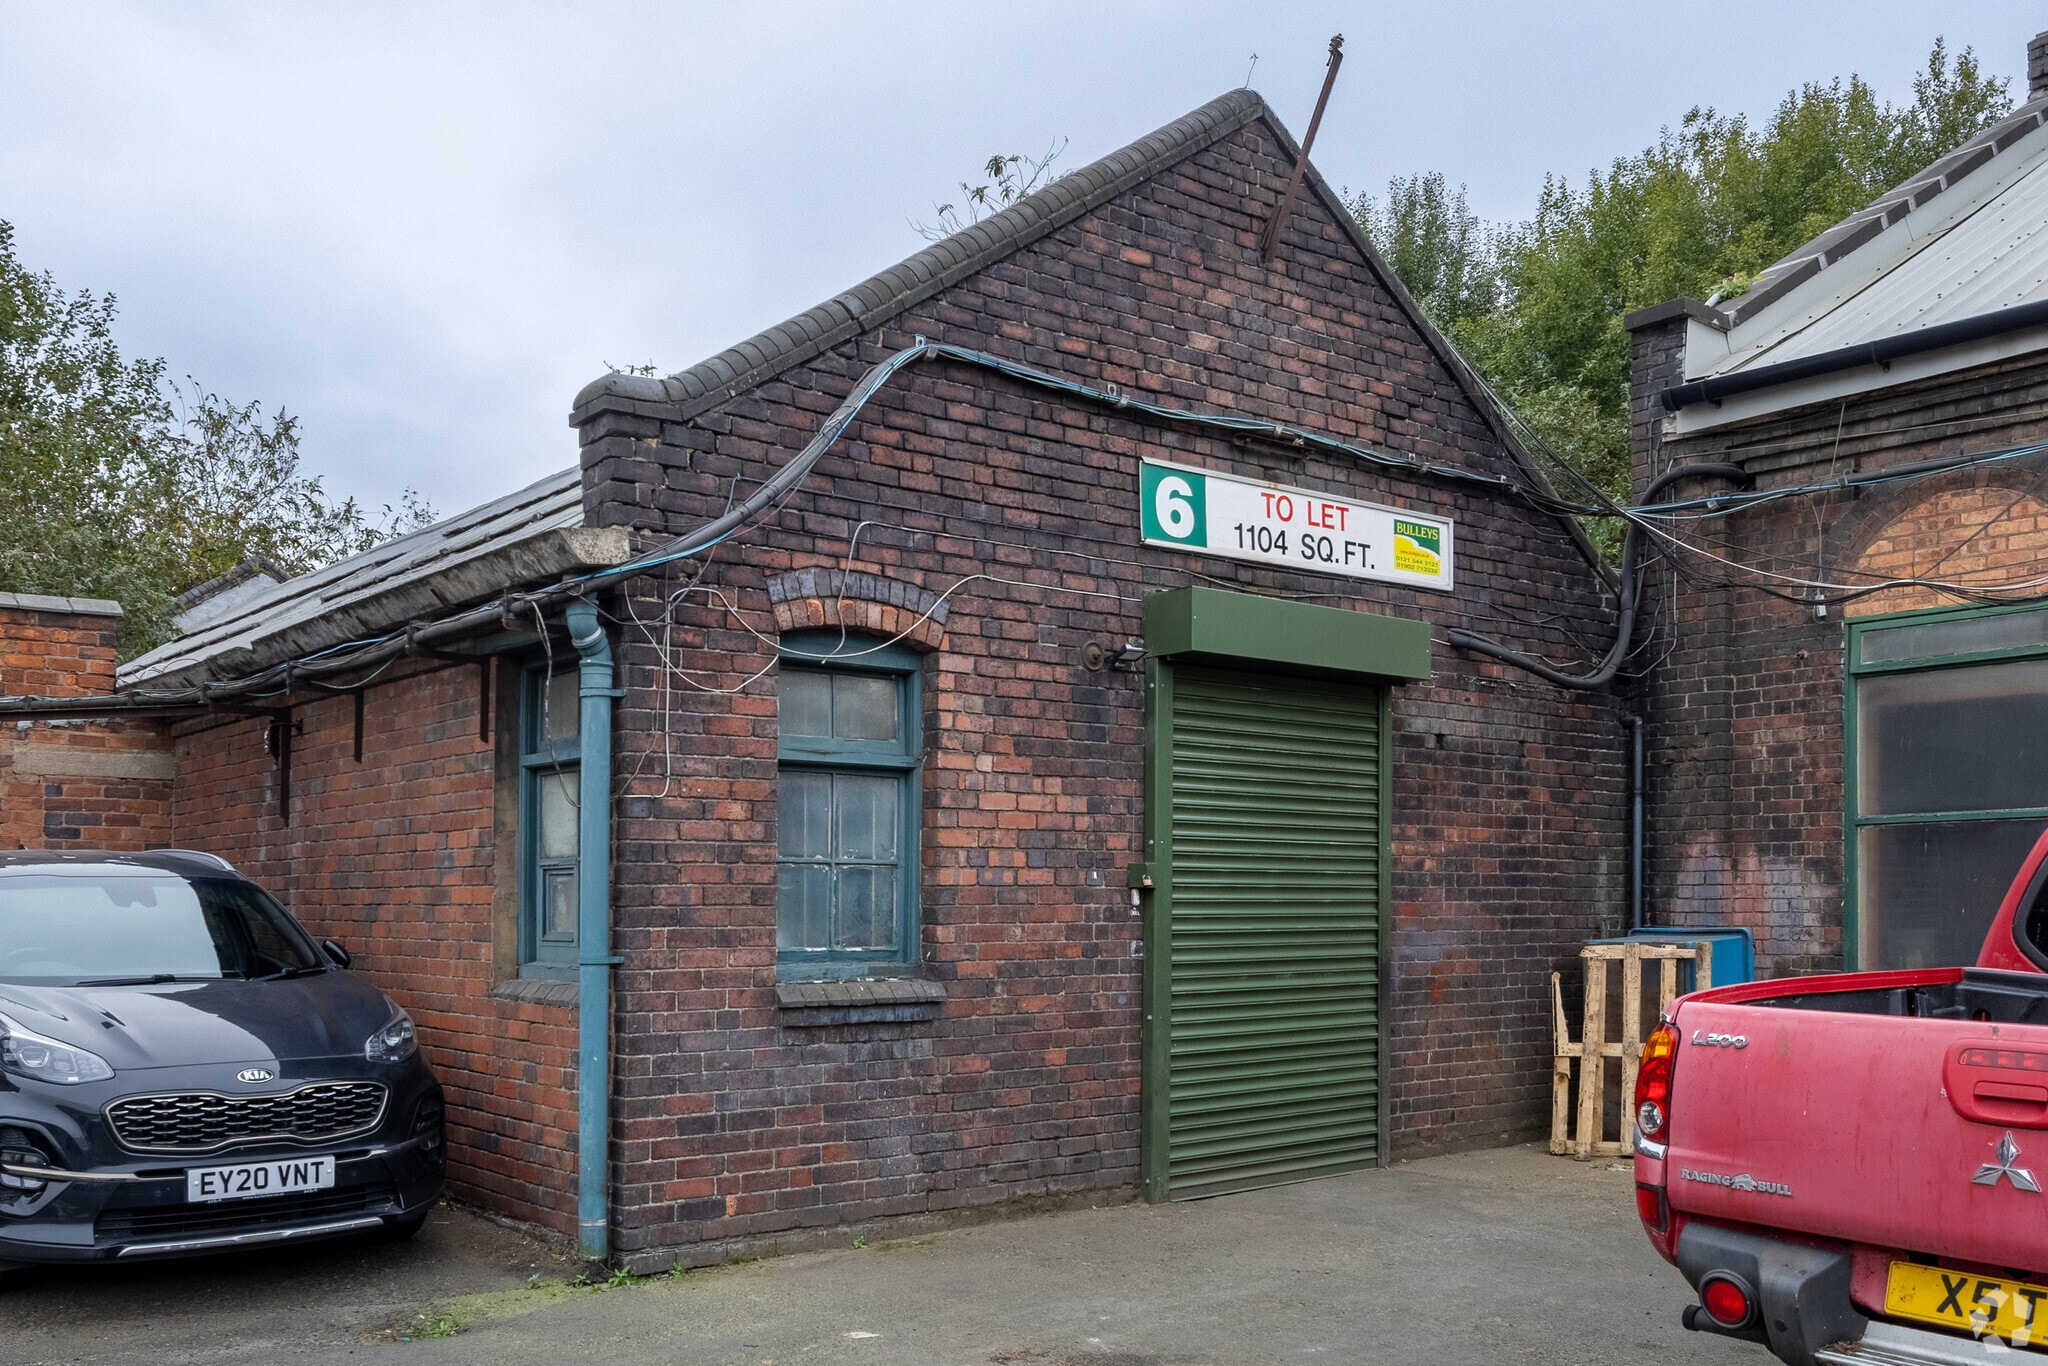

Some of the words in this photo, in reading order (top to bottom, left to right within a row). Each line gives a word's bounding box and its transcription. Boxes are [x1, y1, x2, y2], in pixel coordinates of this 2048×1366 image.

[1155, 475, 1195, 539] 6
[1260, 492, 1294, 522] TO
[1307, 500, 1350, 532] LET
[1233, 523, 1289, 555] 1104
[1396, 522, 1439, 540] BULLEYS
[1395, 555, 1410, 563] 0121
[1691, 1029, 1749, 1049] L200
[243, 1070, 271, 1081] KIA
[200, 1167, 269, 1195] EY20
[277, 1161, 325, 1187] VNT
[1680, 1168, 1732, 1186] RAGING
[1756, 1180, 1792, 1197] BULL
